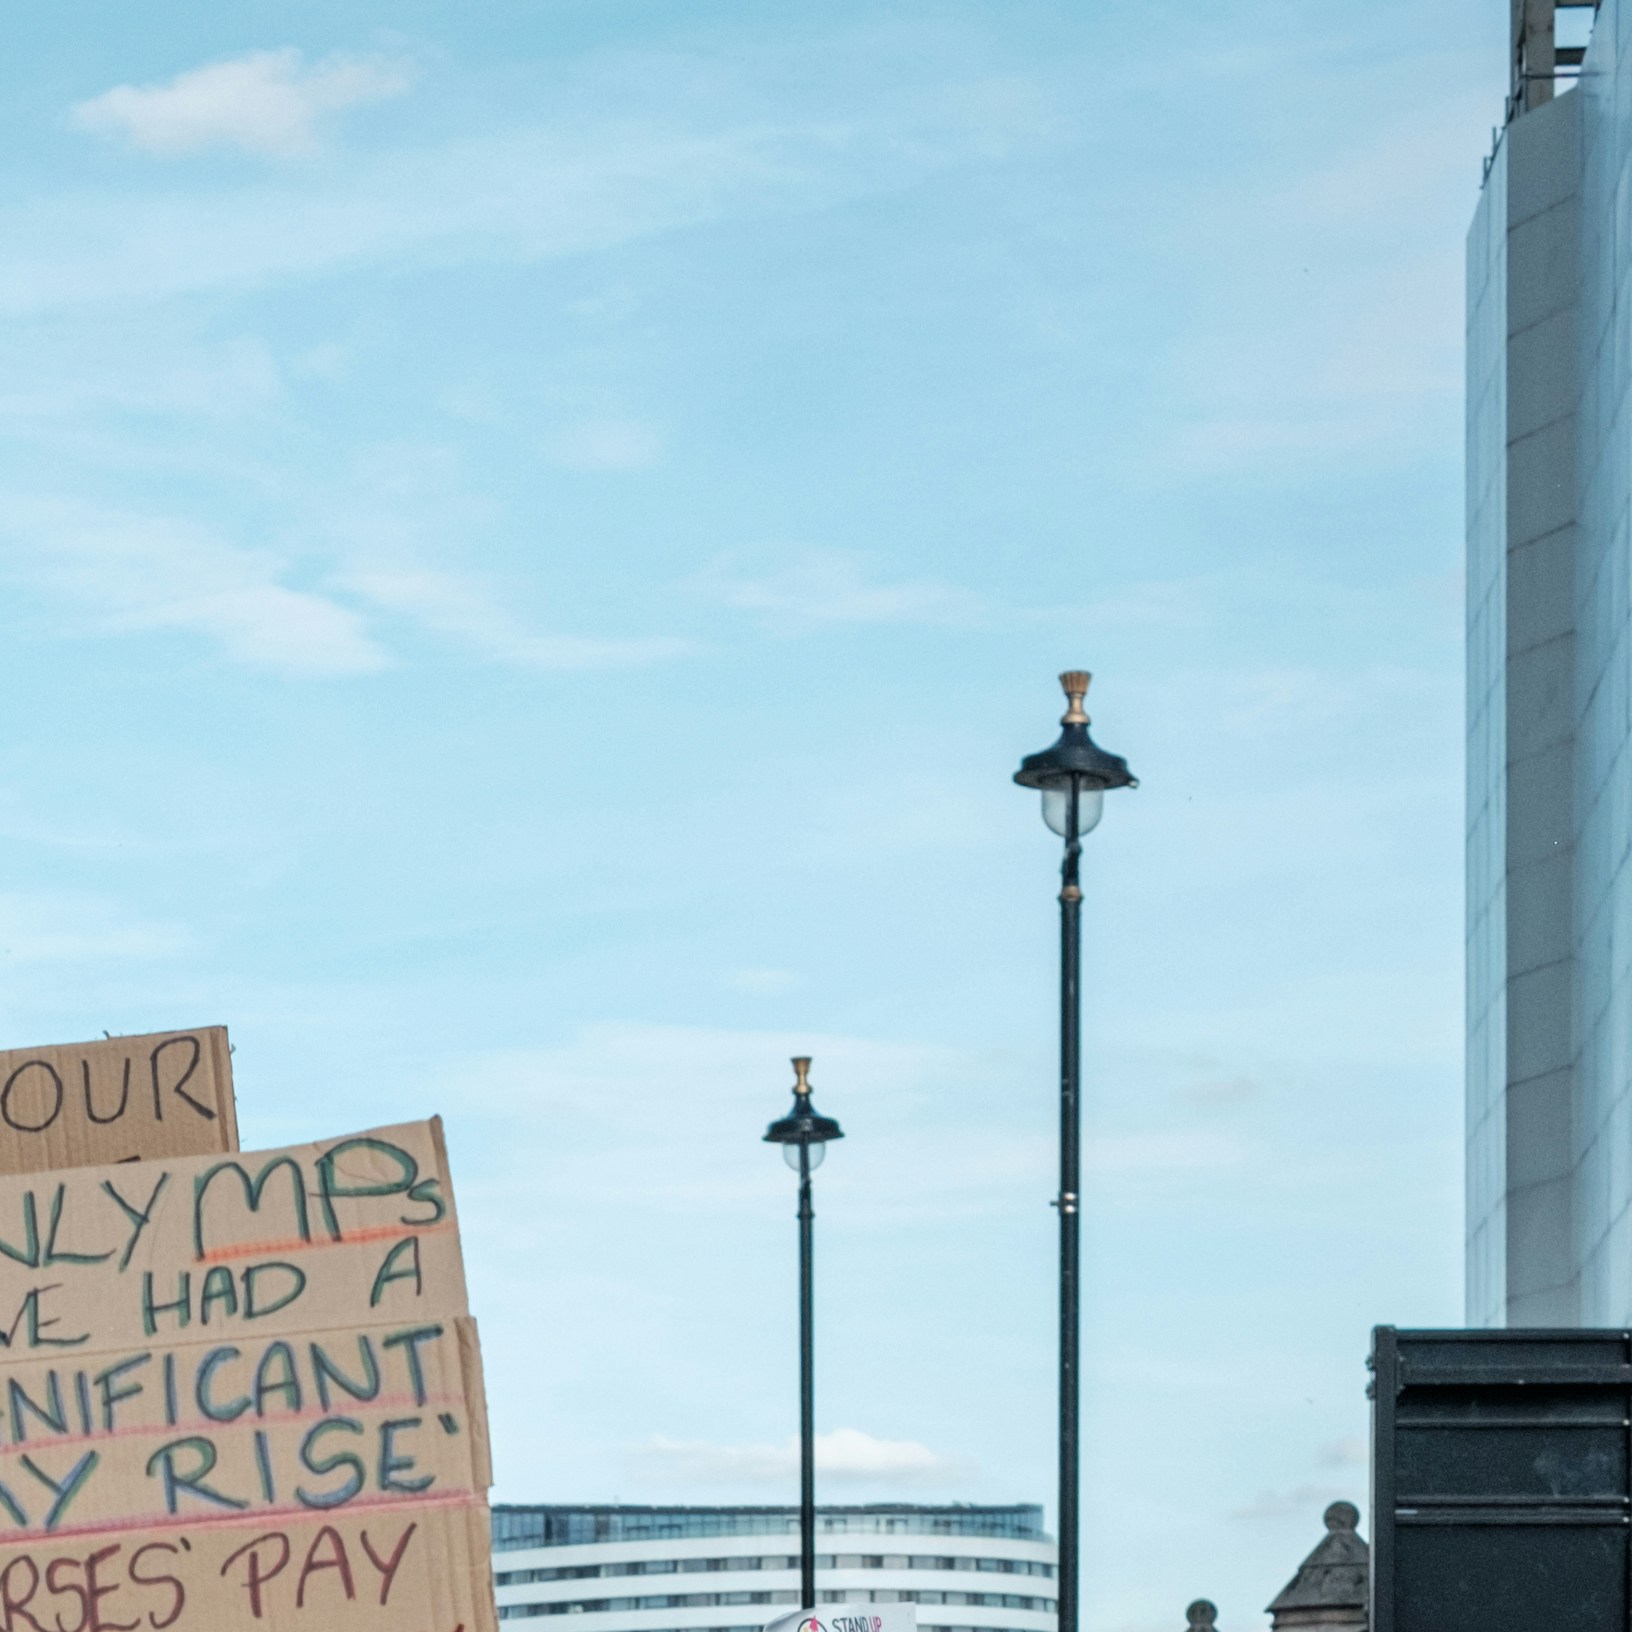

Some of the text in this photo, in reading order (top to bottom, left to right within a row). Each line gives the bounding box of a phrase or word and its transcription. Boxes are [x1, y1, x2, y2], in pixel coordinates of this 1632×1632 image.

[0, 1035, 218, 1133] OUR
[142, 1261, 306, 1336] HAD
[369, 1236, 423, 1308] A
[221, 1522, 418, 1619] PAY
